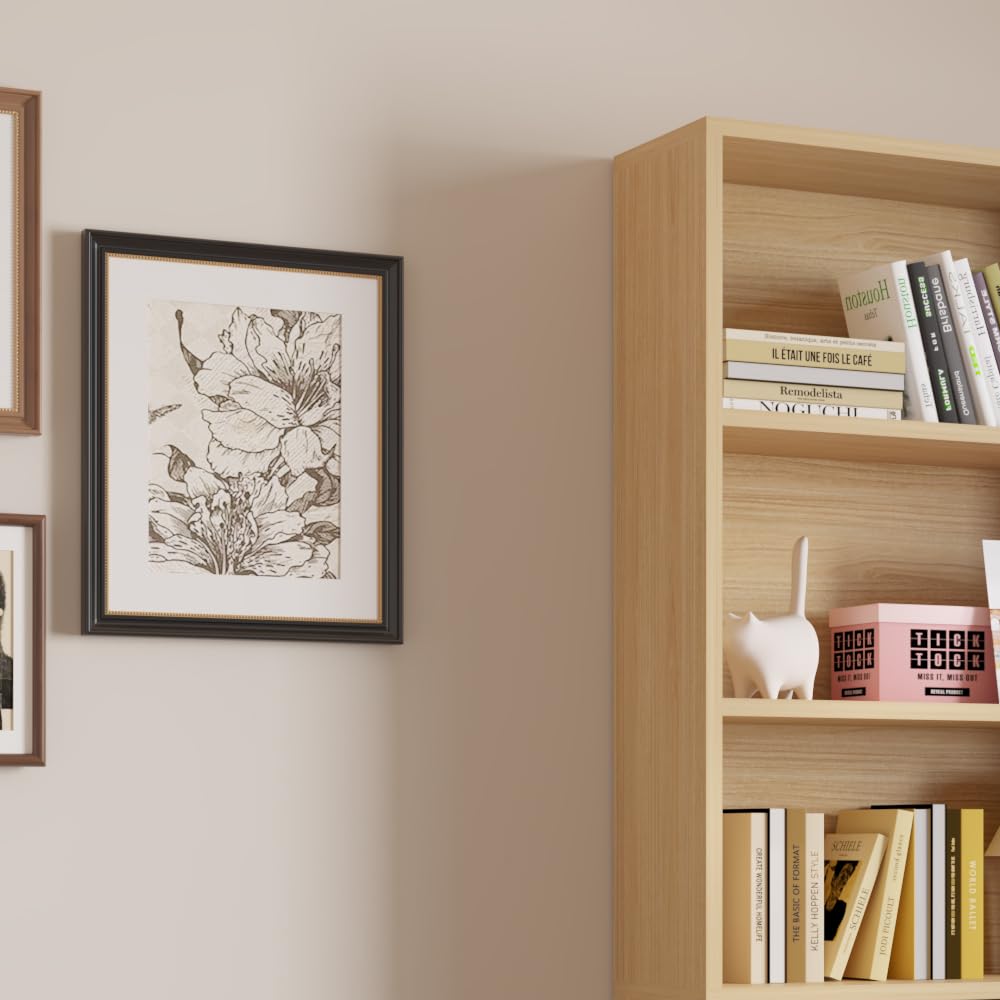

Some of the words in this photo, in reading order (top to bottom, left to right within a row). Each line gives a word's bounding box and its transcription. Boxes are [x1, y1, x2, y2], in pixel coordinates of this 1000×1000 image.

[772, 348, 780, 359] IL
[781, 346, 802, 361] ÉTAIT
[805, 351, 820, 362] UNE
[823, 352, 840, 364] FOIS
[841, 353, 851, 364] LE
[853, 353, 872, 366] CAFÉ
[780, 386, 843, 399] Remodelista
[835, 631, 873, 649] TICK
[914, 631, 980, 648] TICK
[835, 651, 873, 669] TOCK
[914, 652, 980, 669] TOCK
[917, 673, 934, 681] MISS
[792, 844, 800, 881] FORMAT
[811, 851, 819, 879] STYLE
[969, 860, 977, 894] WORLD
[792, 883, 800, 895] OF
[792, 897, 800, 922] BASIC
[811, 882, 819, 920] HOPPEN
[850, 887, 870, 930] SCHIELE
[882, 896, 895, 934] PICOULT
[969, 898, 977, 930] BALLET
[792, 925, 800, 943] THE
[811, 922, 819, 952] KELLY
[880, 935, 889, 955] JODI
